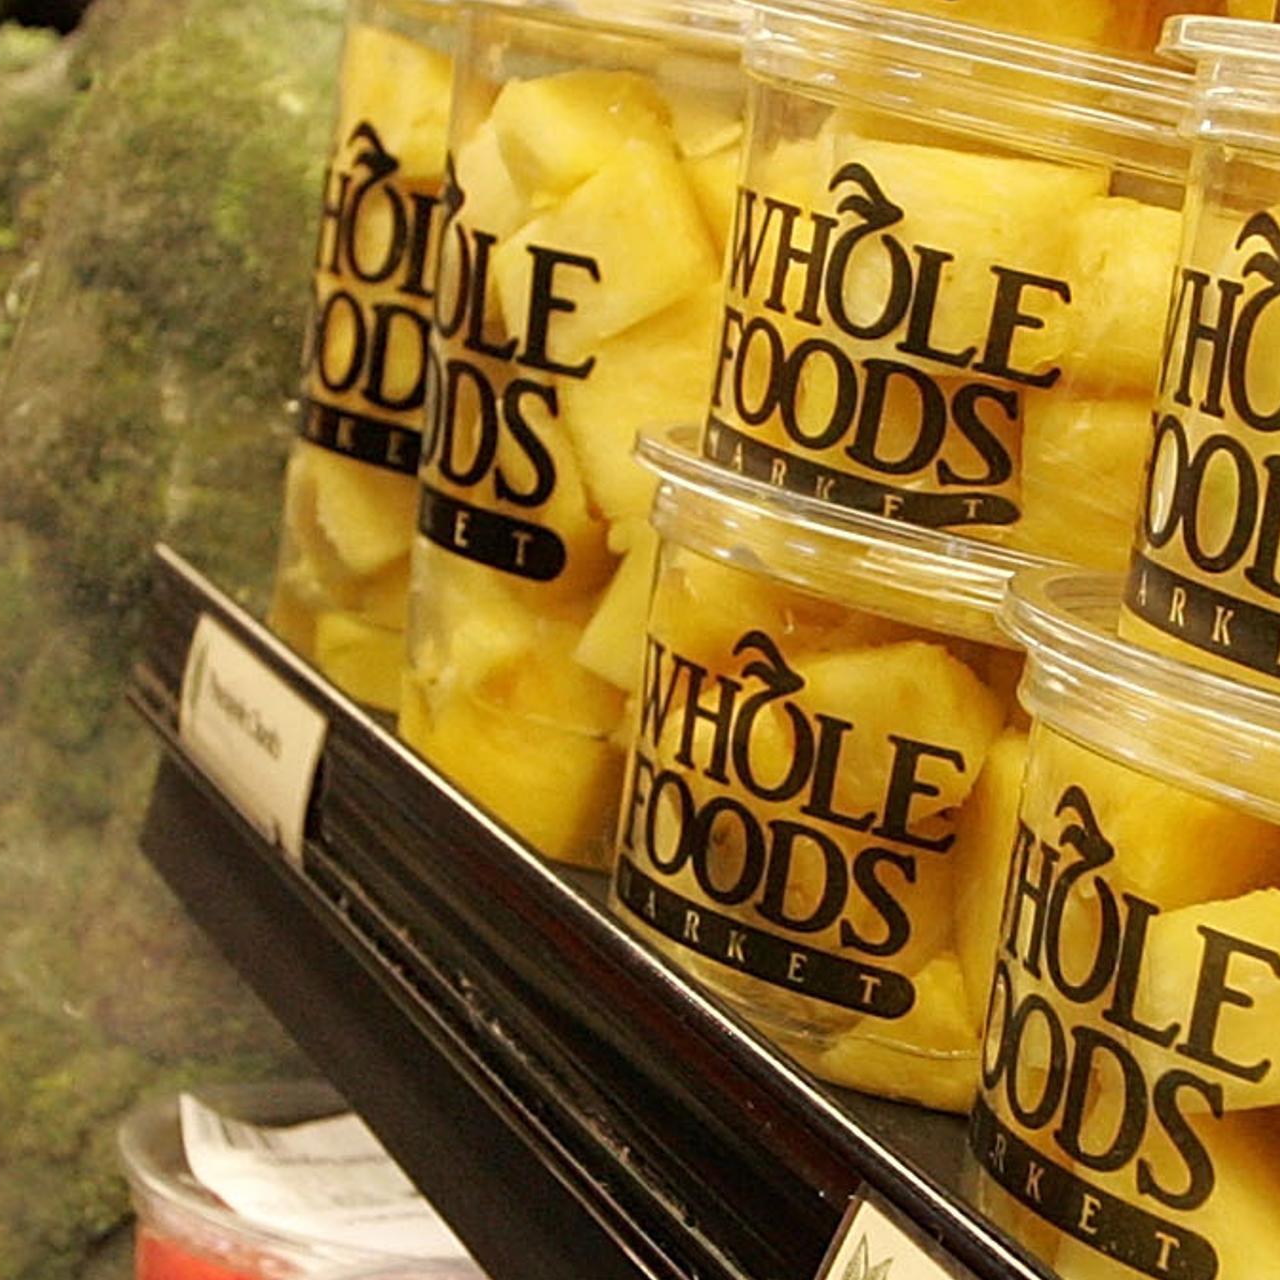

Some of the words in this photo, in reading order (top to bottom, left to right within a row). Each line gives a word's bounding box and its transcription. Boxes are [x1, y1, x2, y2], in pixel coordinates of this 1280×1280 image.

[434, 220, 602, 380] OLE
[730, 185, 1072, 388] WHOLE
[712, 306, 1022, 488] FOODS
[640, 632, 966, 854] WHOLE
[983, 959, 1224, 1212] OODS
[993, 1132, 1182, 1272] RKET
